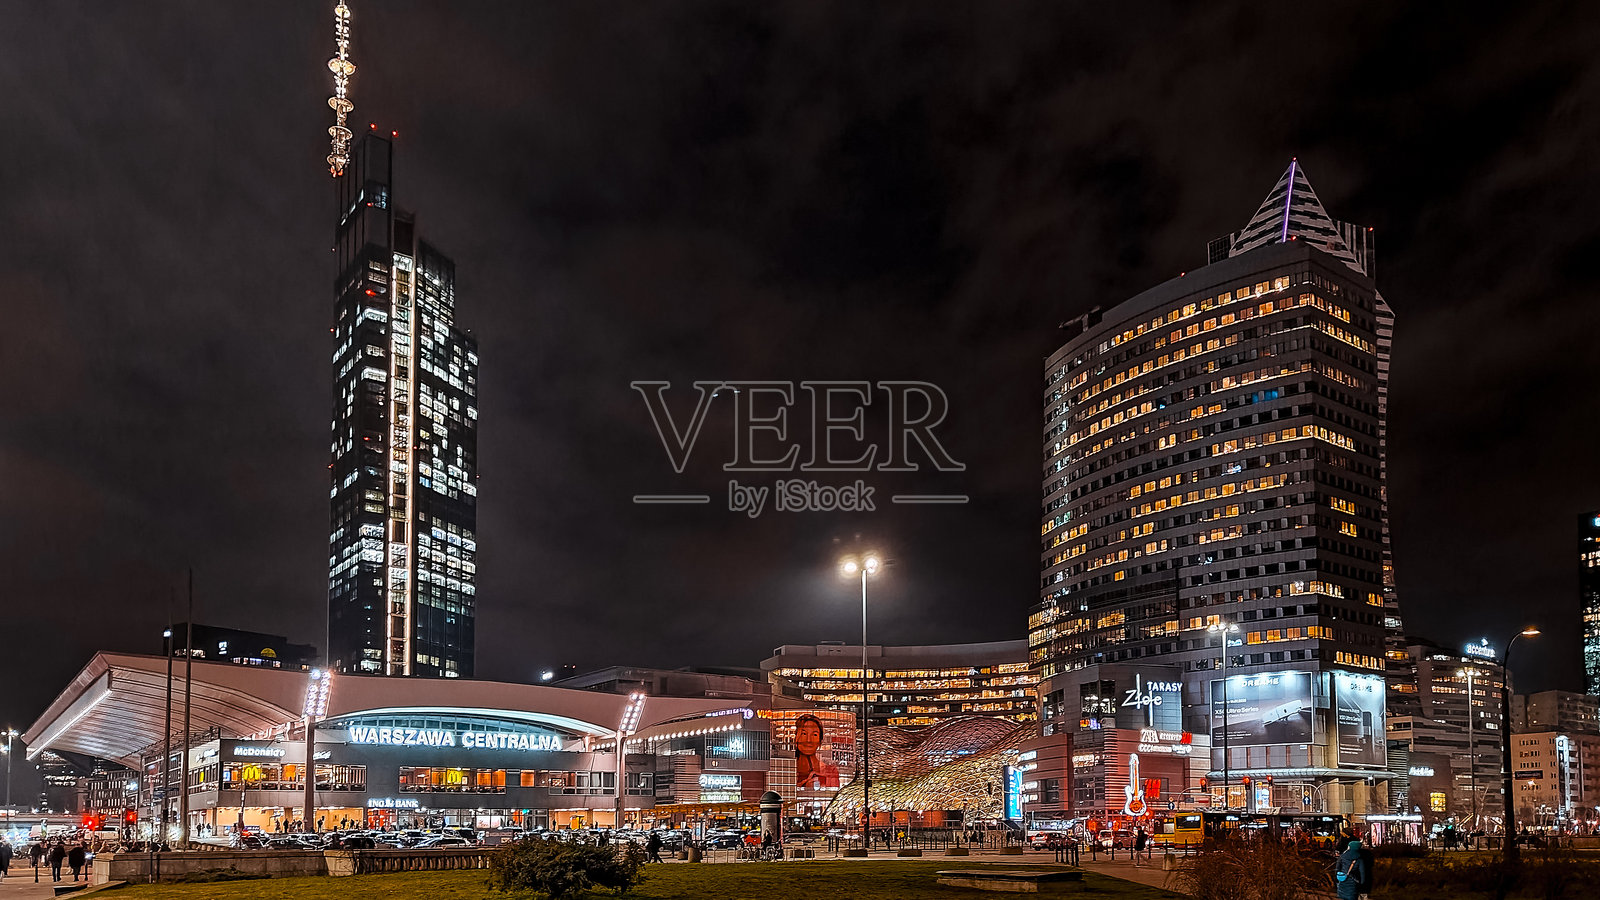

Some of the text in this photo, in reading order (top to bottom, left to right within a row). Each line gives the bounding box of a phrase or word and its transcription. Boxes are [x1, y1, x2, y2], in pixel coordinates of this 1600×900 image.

[1146, 681, 1183, 692] TARASY
[1241, 677, 1280, 688] DREAME
[350, 728, 562, 750] WARSZAWA CENTRALNA
[233, 746, 286, 756] McDonald's
[395, 800, 418, 809] BANK
